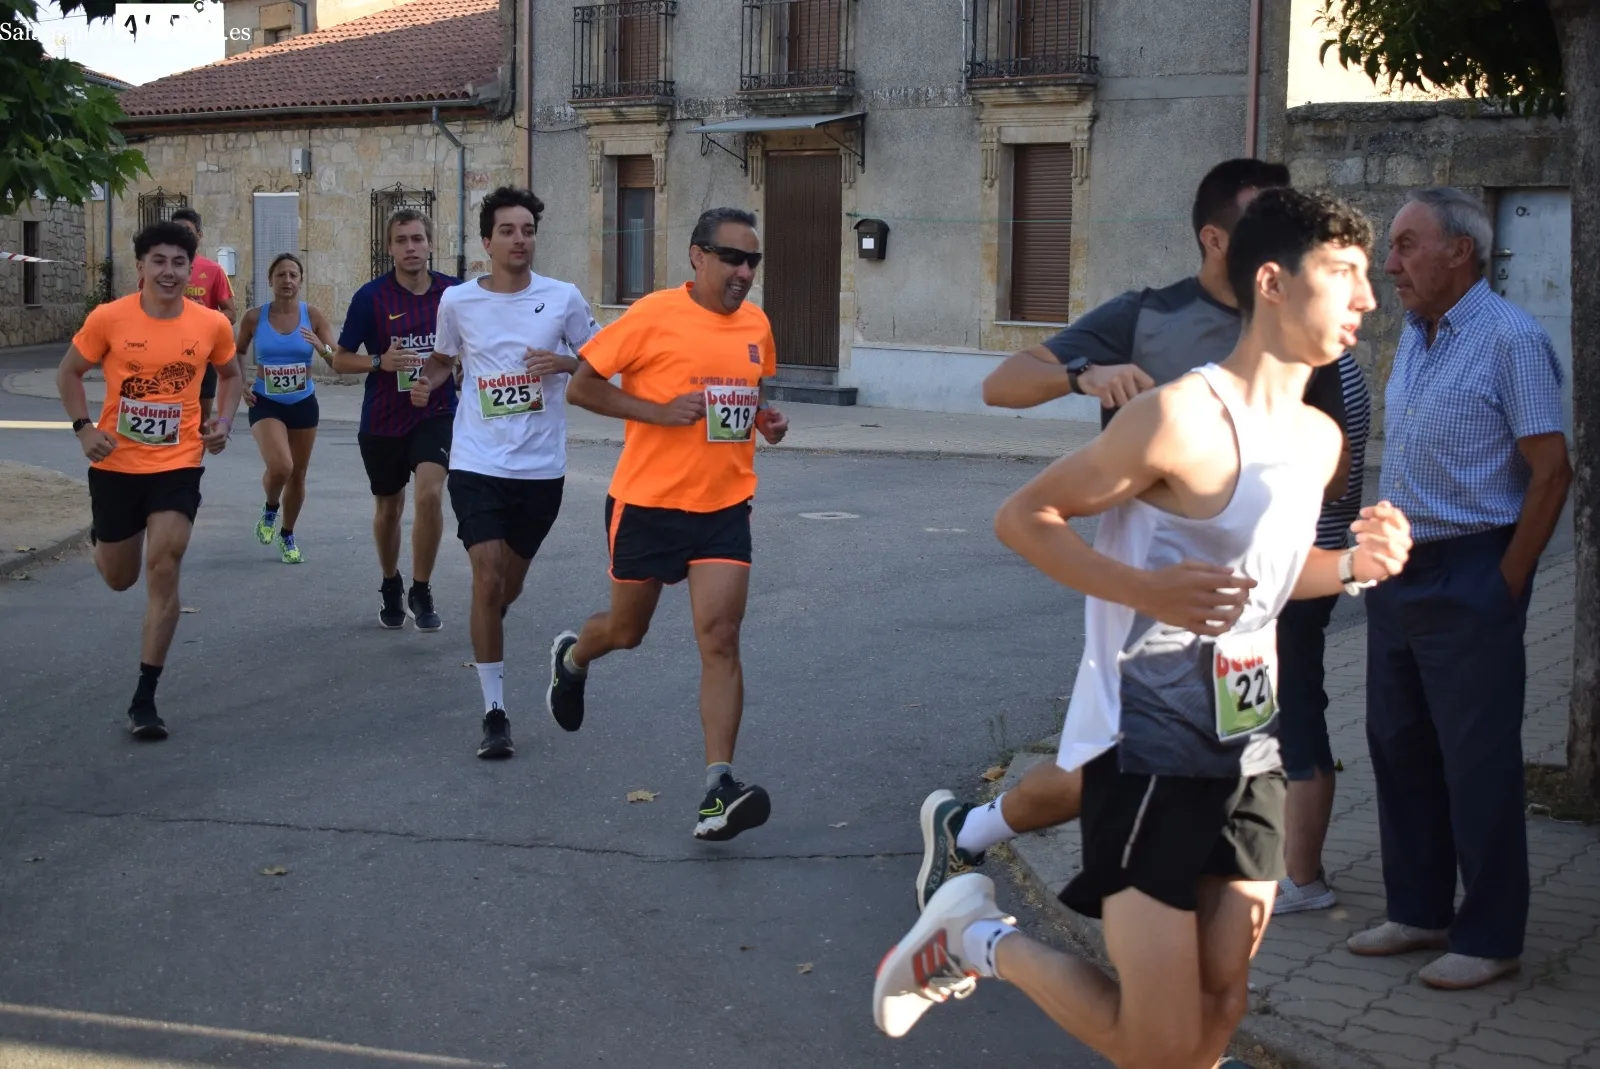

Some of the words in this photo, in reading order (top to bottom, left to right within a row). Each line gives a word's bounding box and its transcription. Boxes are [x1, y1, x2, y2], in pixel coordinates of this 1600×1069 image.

[390, 332, 436, 347] Rakut
[265, 366, 306, 376] bedunia
[273, 375, 298, 388] 231
[491, 385, 531, 407] 225
[708, 390, 758, 406] bedunia
[121, 401, 181, 418] bedunia
[720, 407, 750, 428] 219
[129, 416, 167, 436] 221
